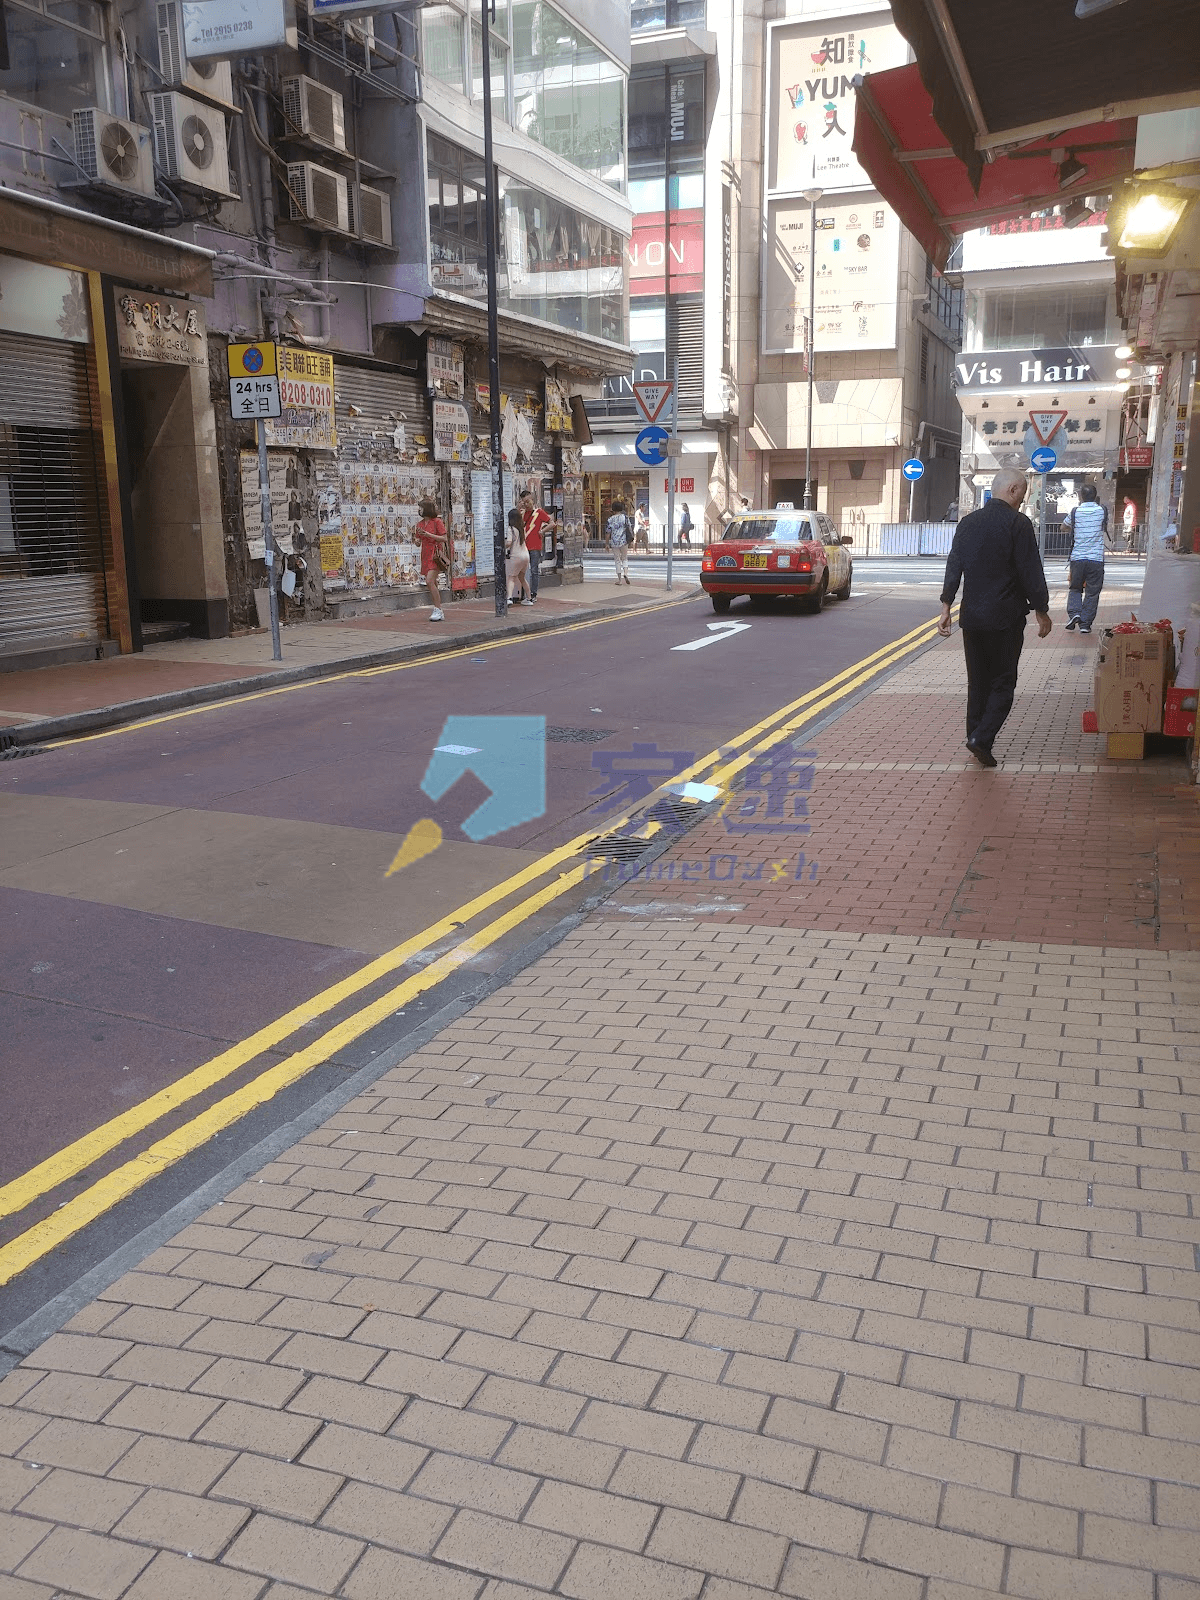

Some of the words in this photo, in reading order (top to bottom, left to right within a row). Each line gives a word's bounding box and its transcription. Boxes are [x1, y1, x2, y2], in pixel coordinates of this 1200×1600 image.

[201, 27, 213, 38] Tel
[214, 24, 232, 36] 2915
[233, 20, 253, 32] 0238
[819, 37, 845, 66] 知
[671, 102, 684, 141] MUJI
[828, 161, 850, 170] Theatre
[788, 223, 804, 231] MUJI
[957, 362, 1003, 385] Vis
[1019, 358, 1091, 383] Hair
[236, 382, 252, 394] 24
[255, 381, 273, 393] hrs
[240, 398, 270, 414] 全日
